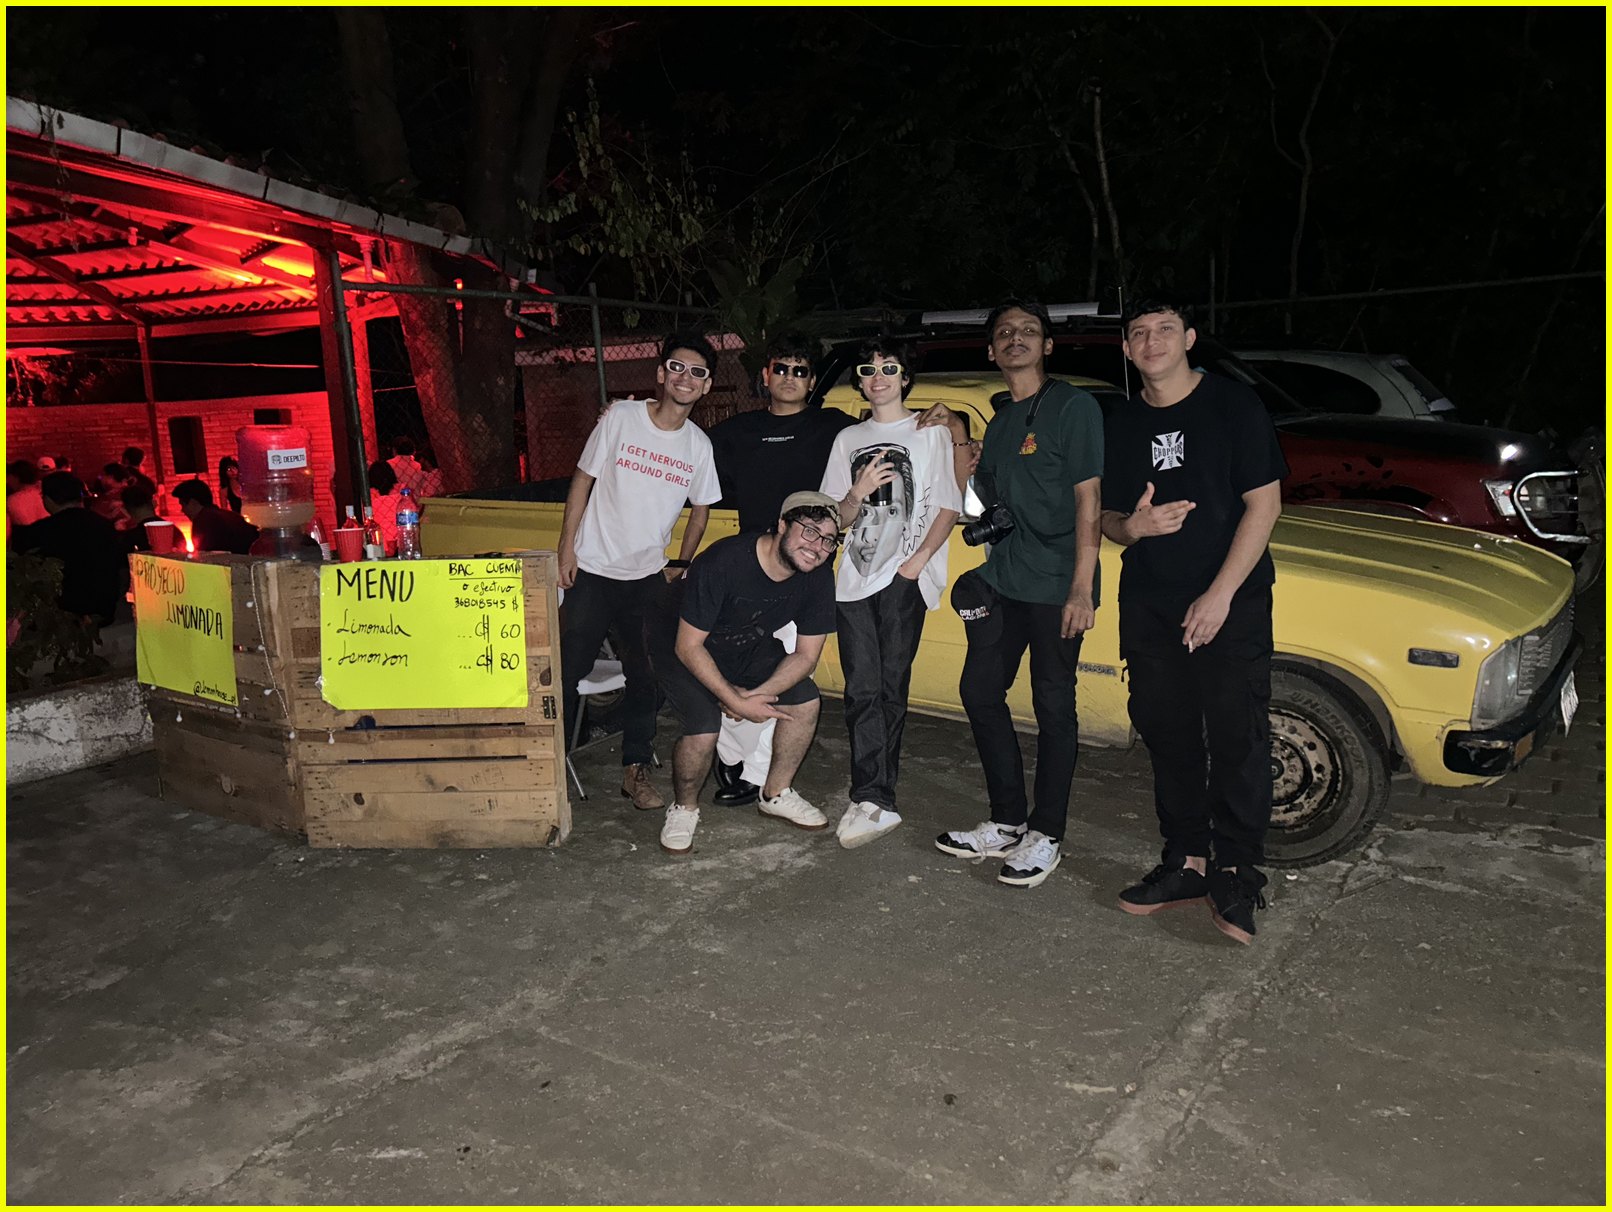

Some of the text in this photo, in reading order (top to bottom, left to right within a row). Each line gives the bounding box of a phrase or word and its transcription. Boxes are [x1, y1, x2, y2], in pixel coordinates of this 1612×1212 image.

[615, 457, 691, 488] AROUND GIRLS
[620, 442, 694, 474] I GET NERVOUS
[136, 559, 185, 596] PROYECTO
[336, 567, 414, 602] MENU
[449, 562, 474, 577] BAC
[473, 580, 515, 596] efectivo
[166, 601, 224, 640] LIMONADA
[336, 608, 412, 637] Limonada
[500, 624, 521, 639] 60
[500, 652, 520, 671] 80
